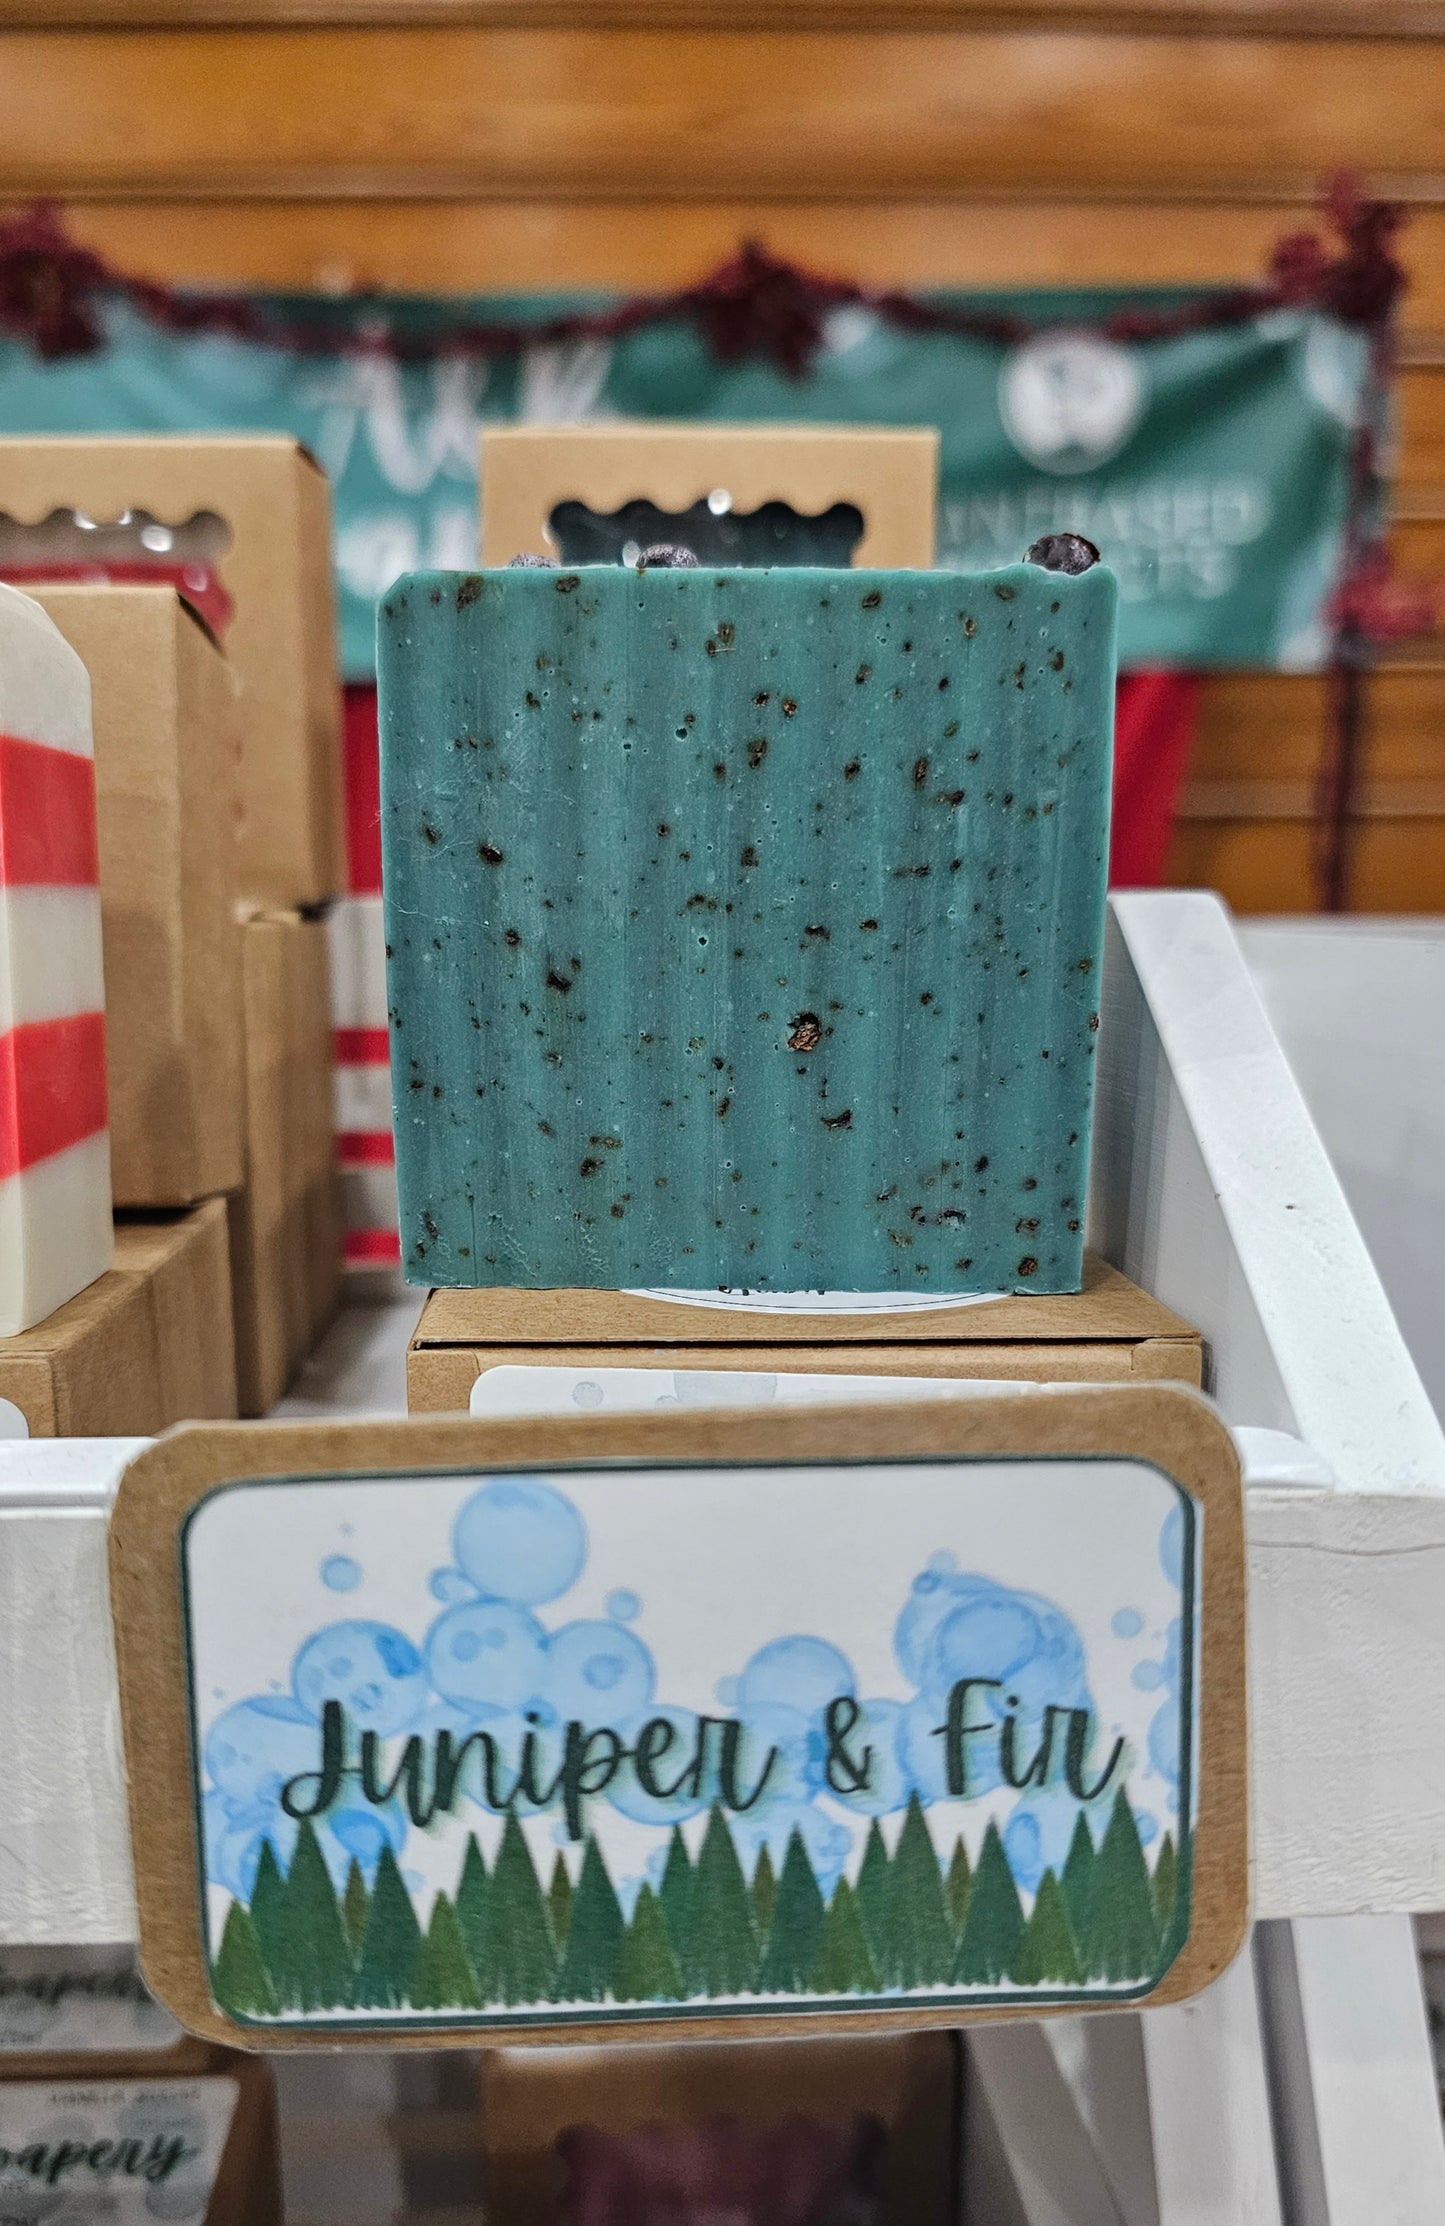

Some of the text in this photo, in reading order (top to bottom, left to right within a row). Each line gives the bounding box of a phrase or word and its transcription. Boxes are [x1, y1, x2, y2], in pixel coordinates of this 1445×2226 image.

[280, 1677, 1126, 1841] Juniper & Fir
